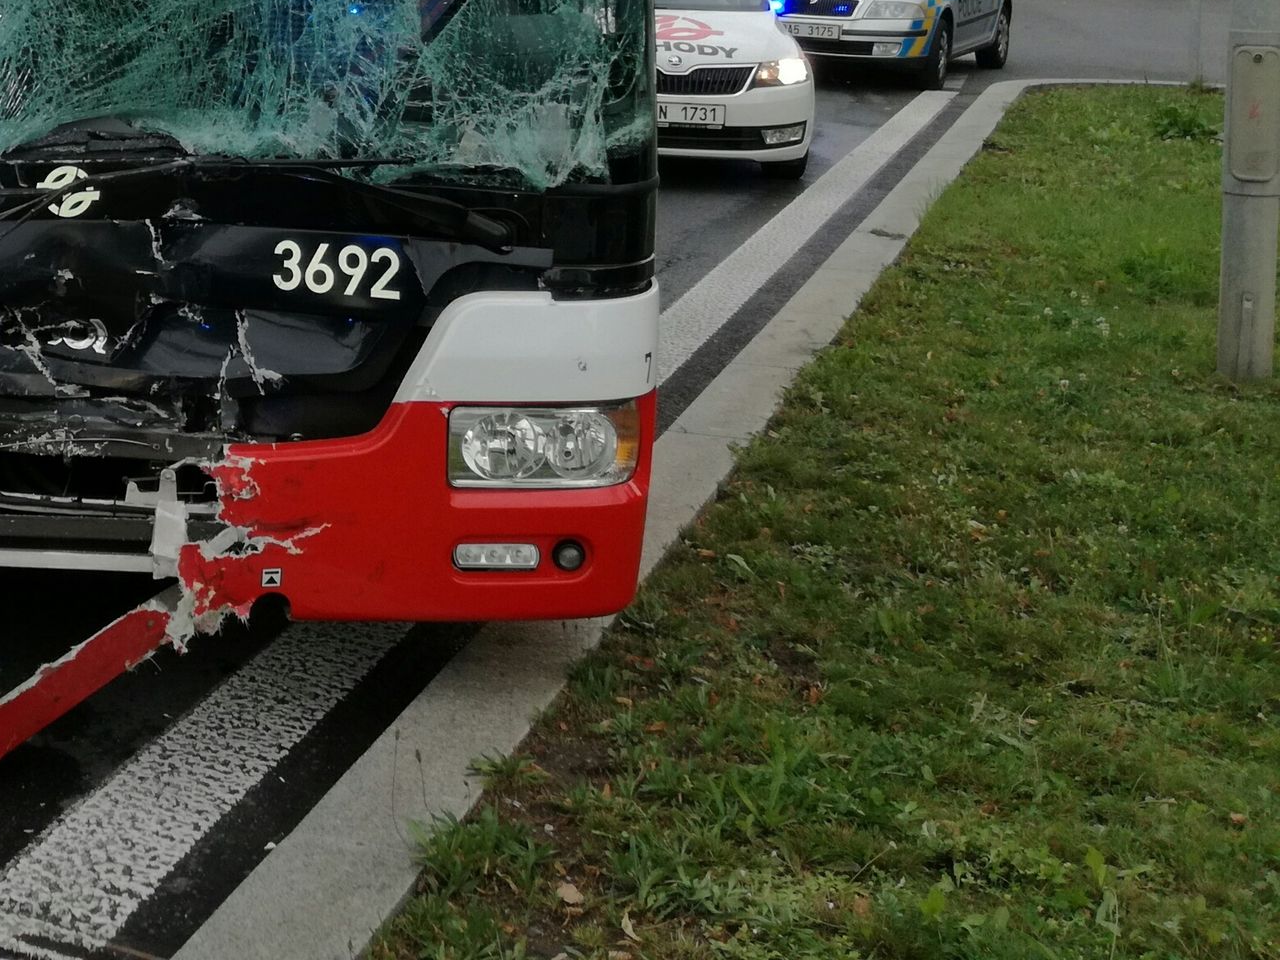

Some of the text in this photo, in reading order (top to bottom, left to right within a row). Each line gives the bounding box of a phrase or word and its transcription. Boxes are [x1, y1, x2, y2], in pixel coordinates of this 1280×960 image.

[807, 25, 834, 37] 3175
[680, 106, 716, 121] 1731
[272, 239, 401, 301] 3692
